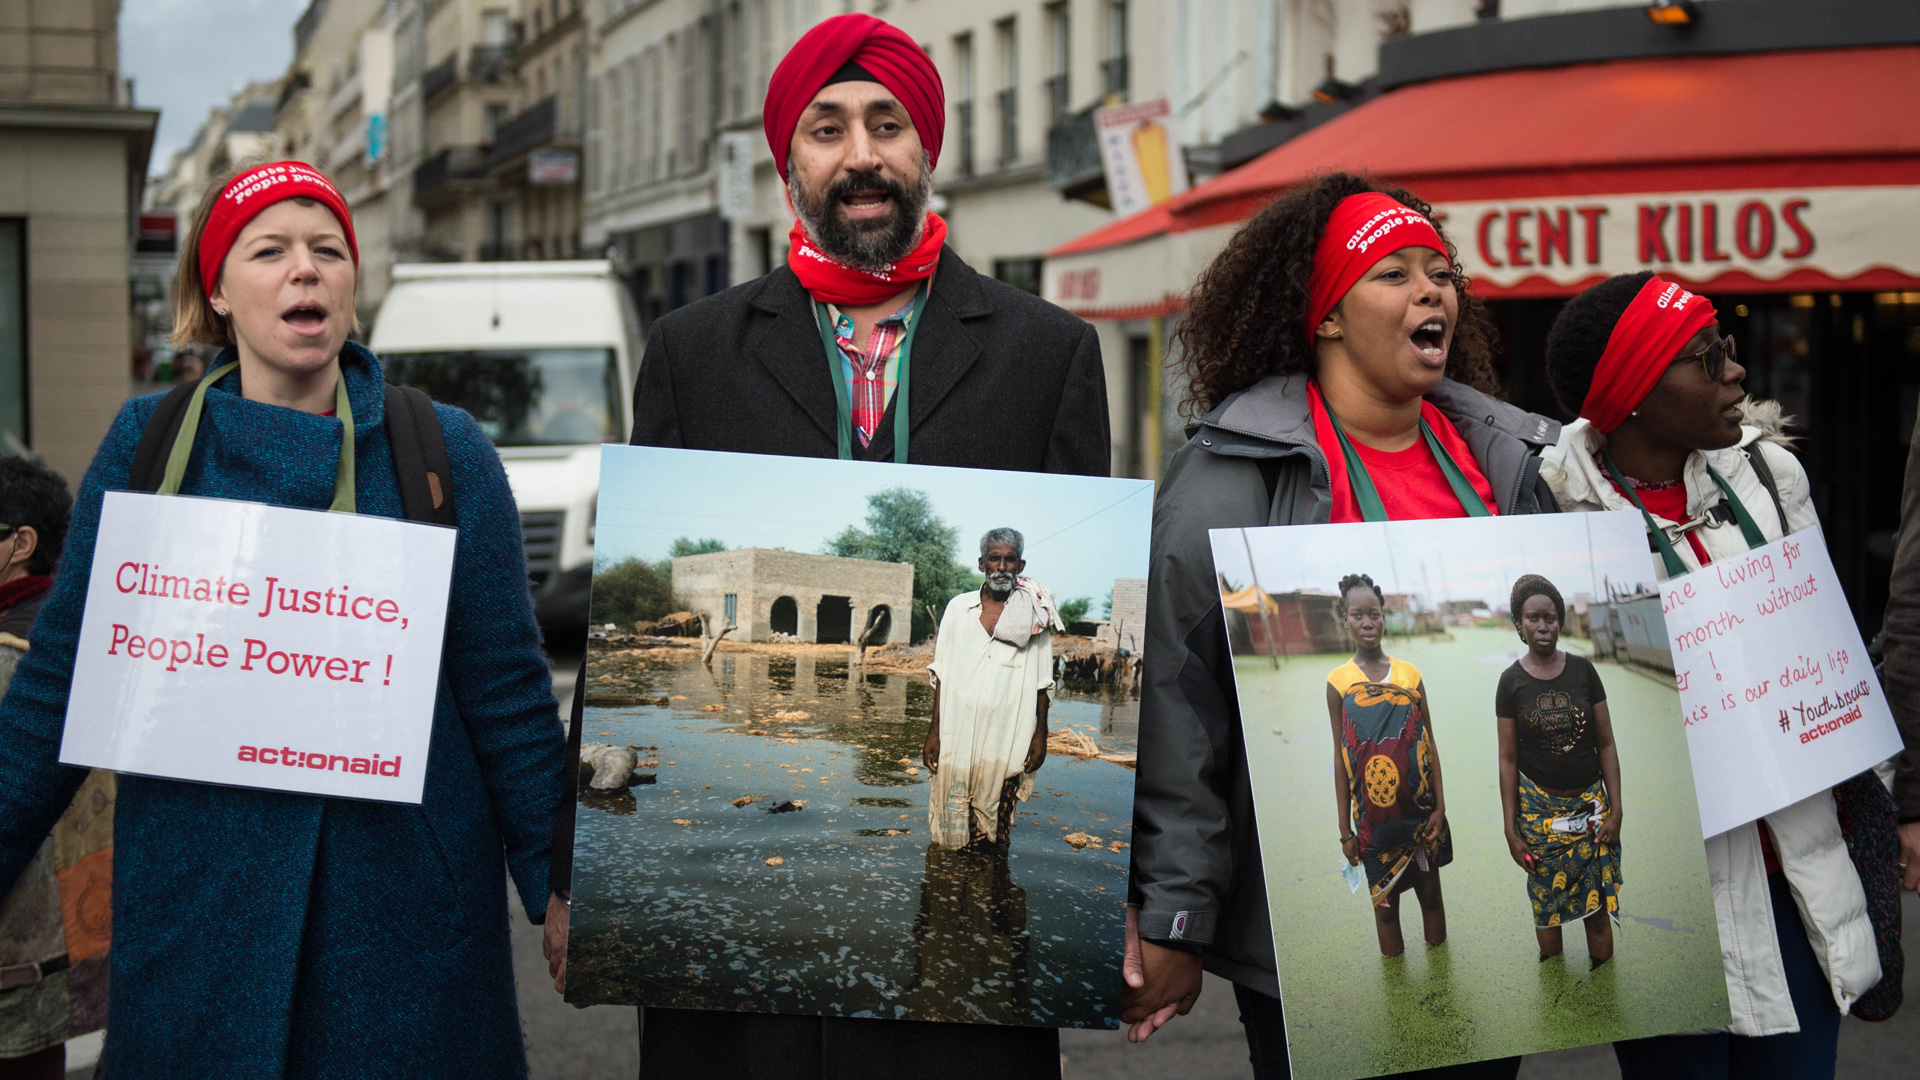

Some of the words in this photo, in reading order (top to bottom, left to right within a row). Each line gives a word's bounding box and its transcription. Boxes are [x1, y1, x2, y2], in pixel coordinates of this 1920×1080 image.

[1347, 208, 1397, 250] Climate
[1477, 207, 1606, 267] CENT
[1638, 200, 1814, 262] KILOS
[1672, 290, 1694, 311] Peop
[116, 562, 250, 605] Climate
[258, 576, 408, 630] Justice,
[1717, 554, 1775, 590] living
[1783, 541, 1801, 570] for
[1675, 611, 1745, 651] month
[1757, 574, 1818, 616] without
[108, 624, 229, 672] People
[240, 638, 370, 683] Power
[1720, 689, 1737, 712] is
[1744, 680, 1771, 703] our
[1779, 654, 1824, 688] daily
[1827, 648, 1850, 674] life
